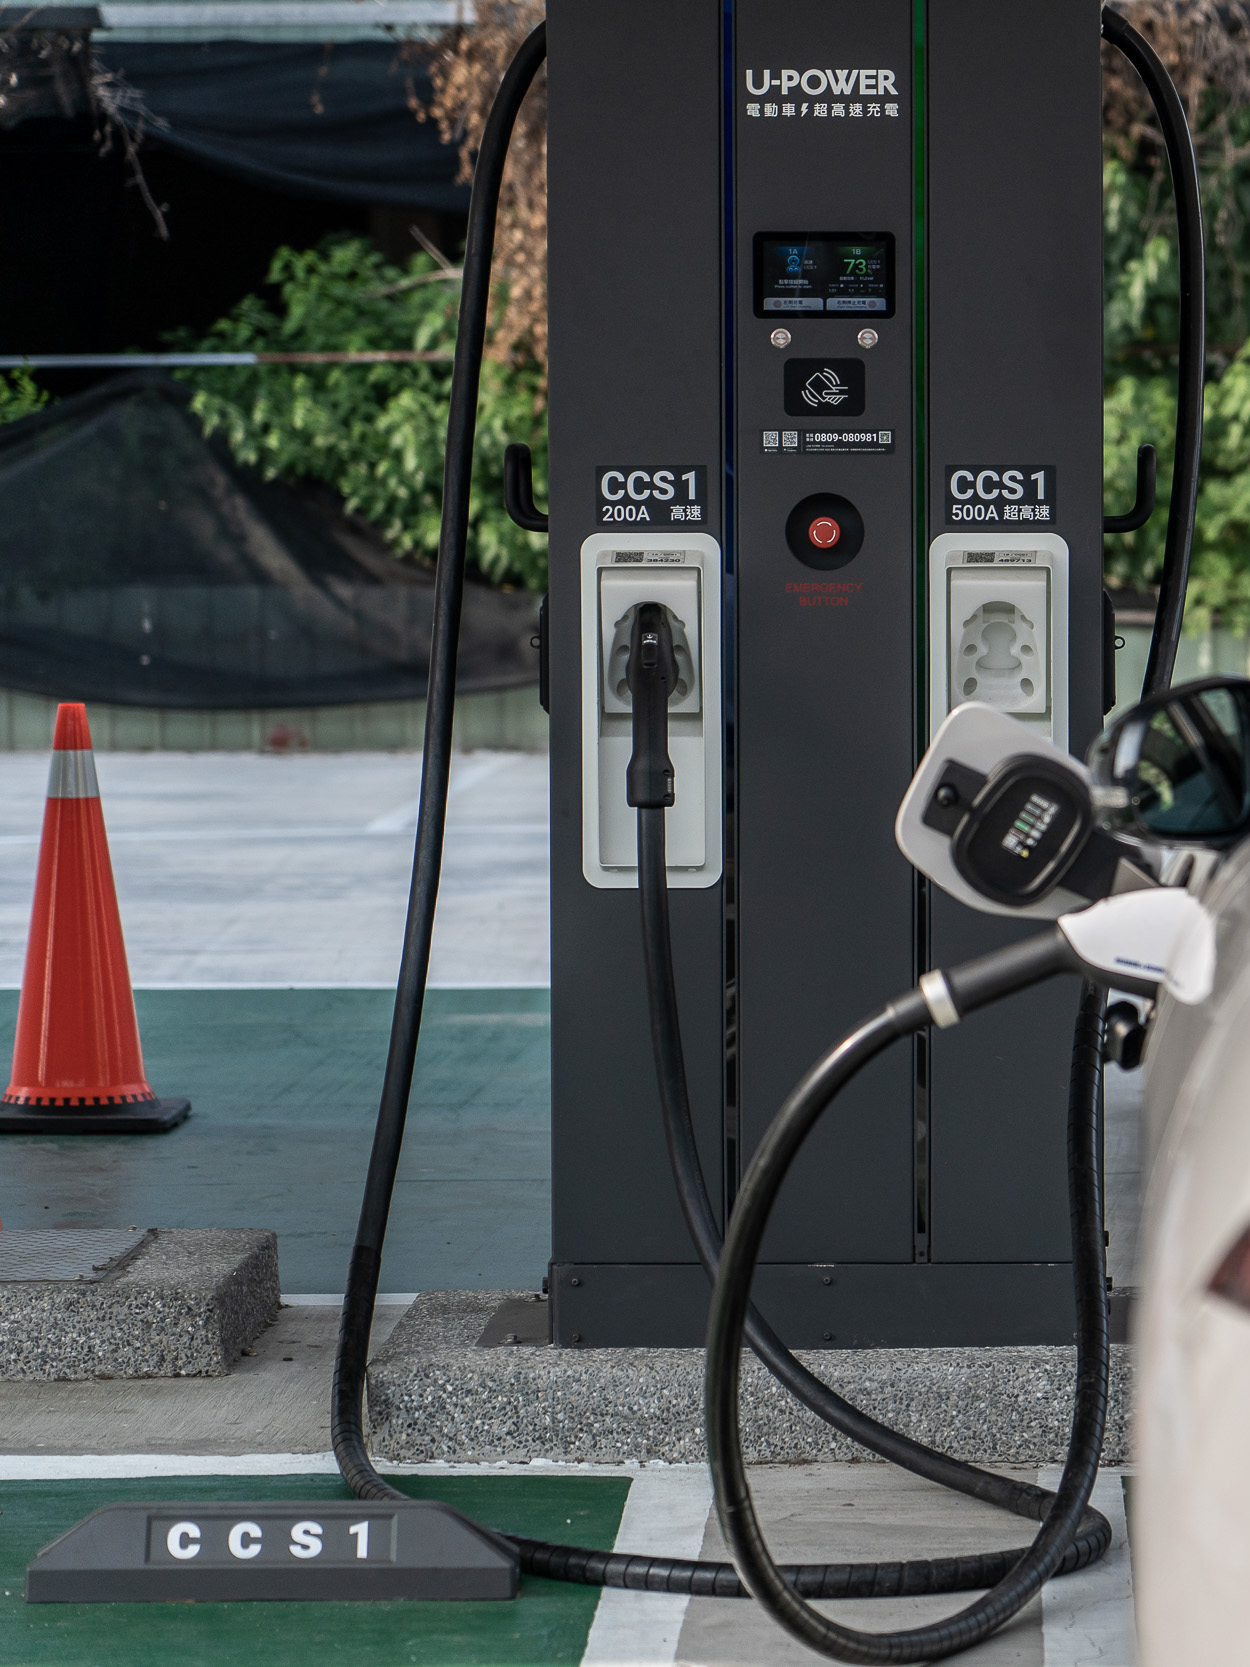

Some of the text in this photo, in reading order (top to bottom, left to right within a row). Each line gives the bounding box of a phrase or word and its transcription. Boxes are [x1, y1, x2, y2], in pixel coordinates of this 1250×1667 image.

[745, 68, 899, 96] U-POWER
[843, 258, 867, 275] 73
[814, 432, 877, 442] 0809-080981
[602, 505, 702, 522] 200A 高速
[951, 504, 1051, 521] 500A 超高速
[785, 582, 863, 593] EMERGENCY
[799, 596, 849, 606] BUTTON
